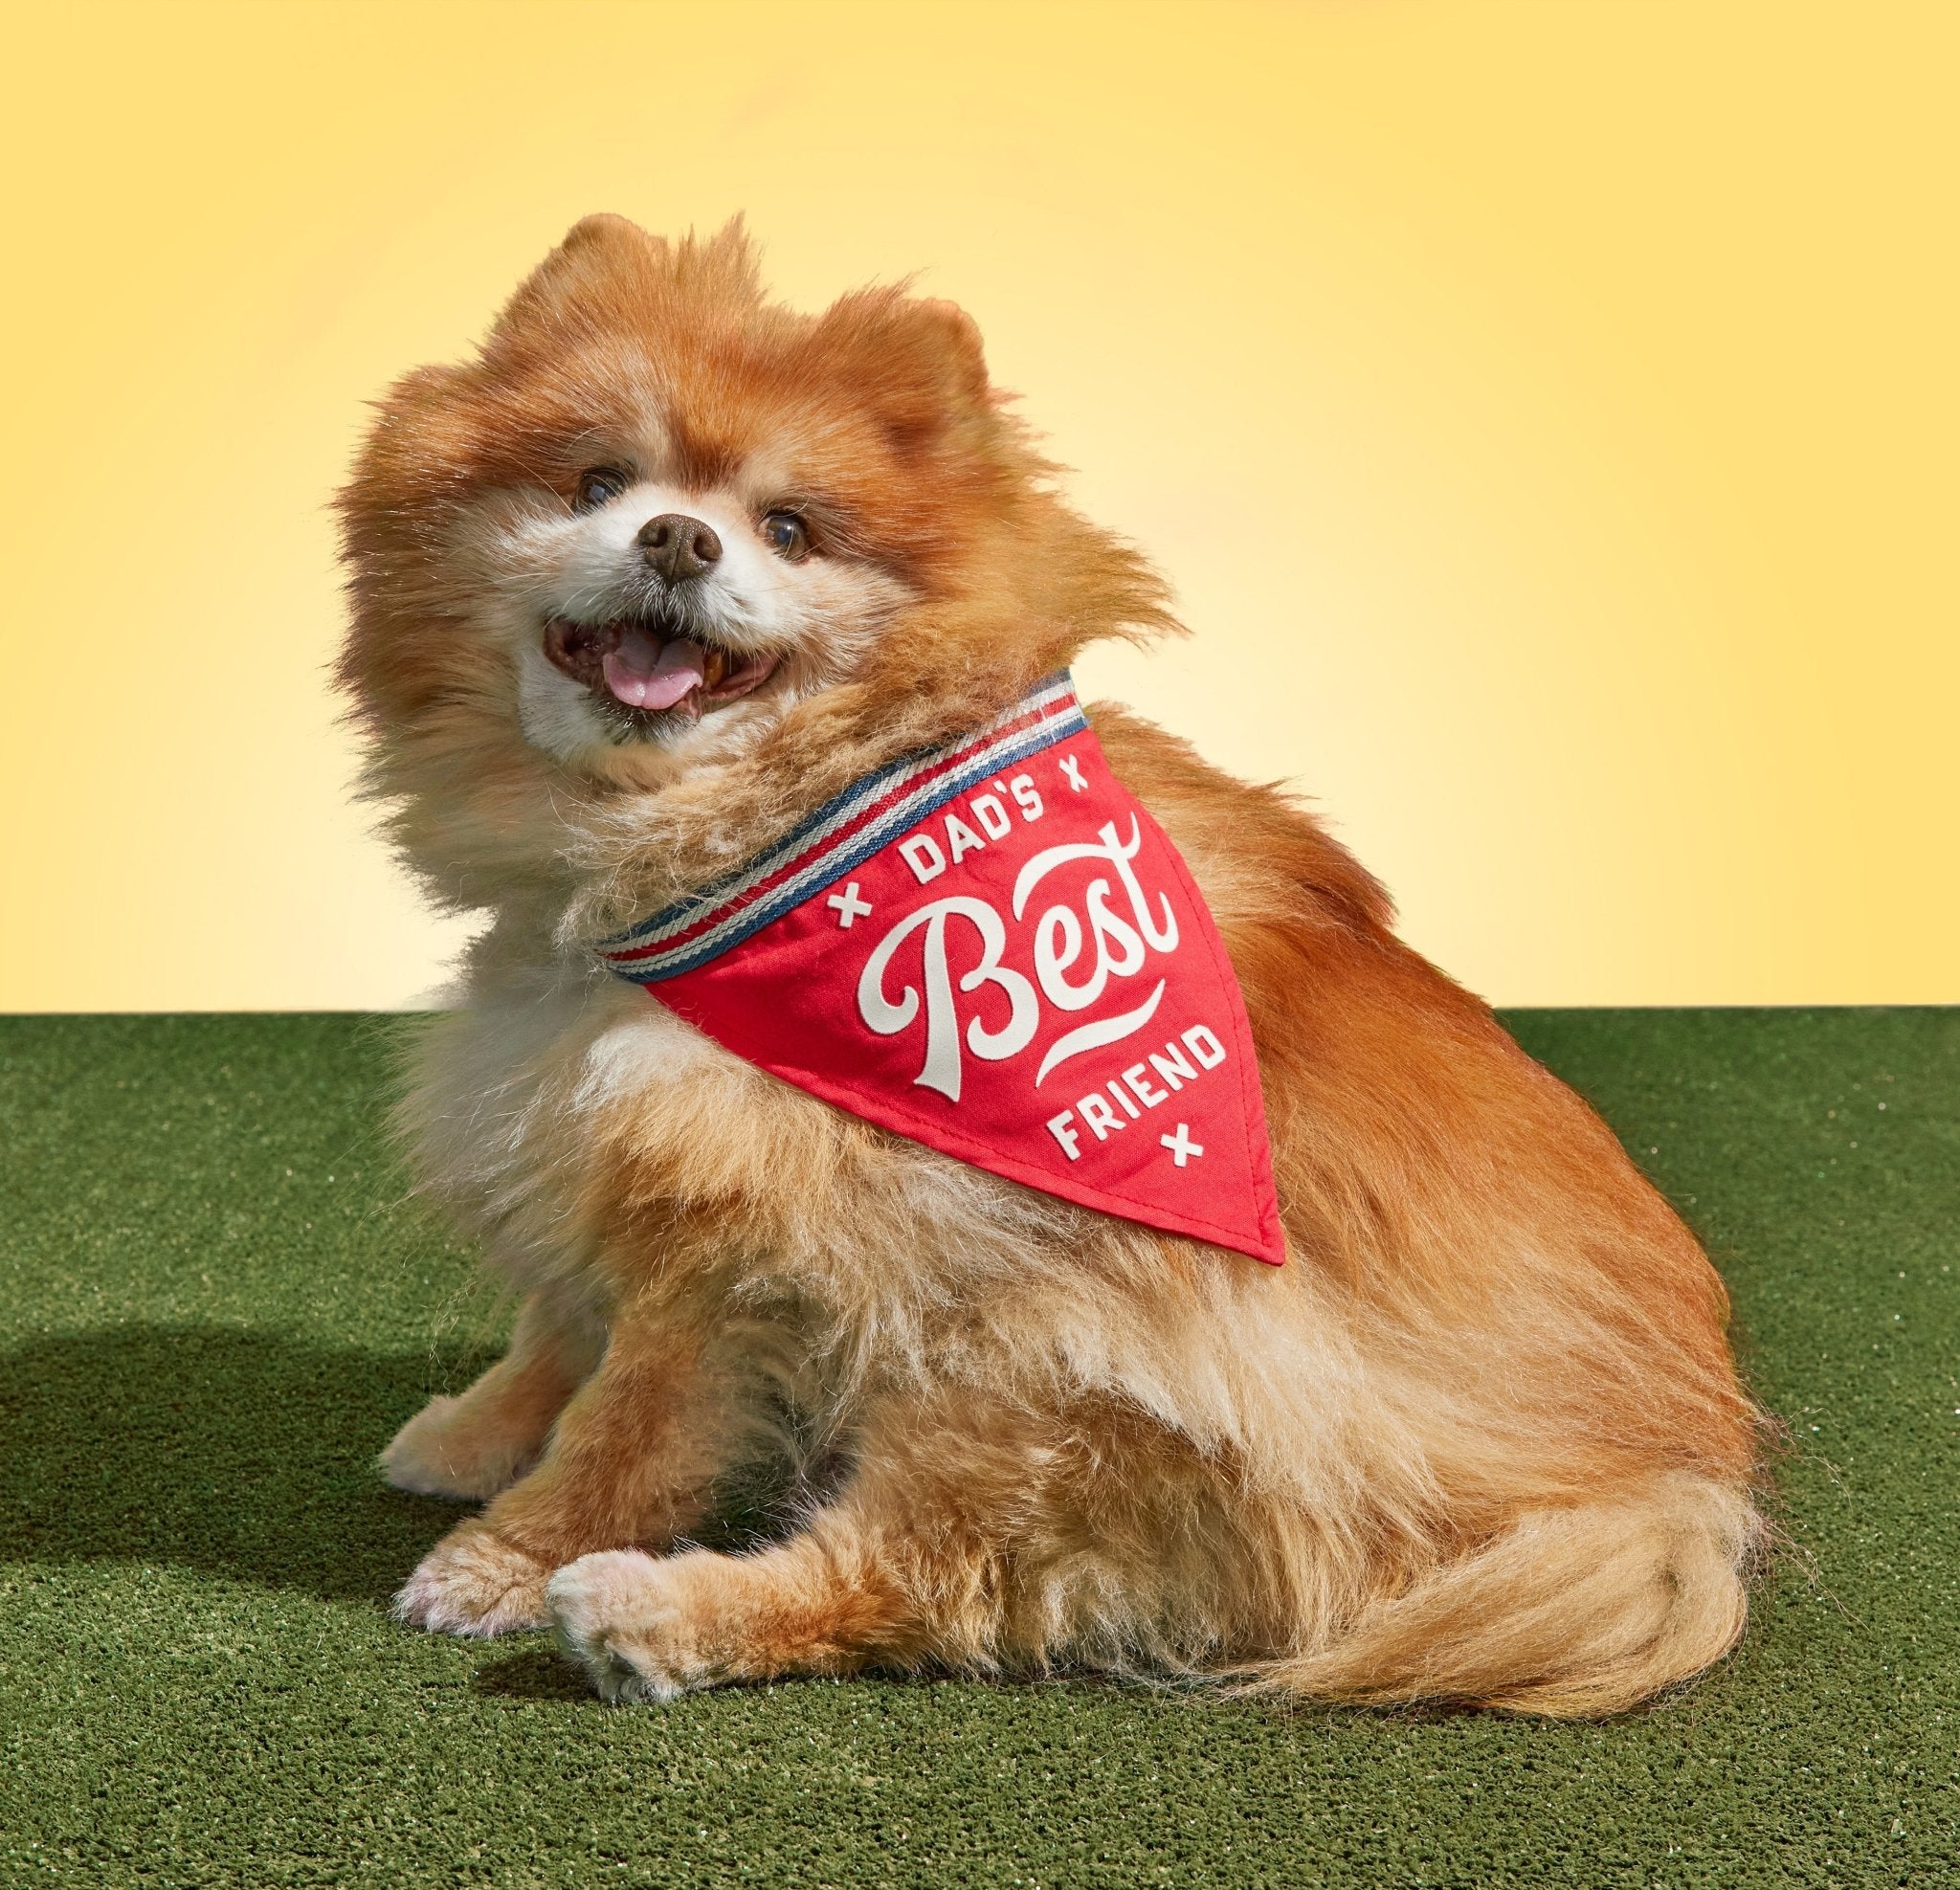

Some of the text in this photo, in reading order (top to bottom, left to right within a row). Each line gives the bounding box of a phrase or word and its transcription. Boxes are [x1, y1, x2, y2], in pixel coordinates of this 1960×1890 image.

[898, 773, 1044, 884] DAD'S
[857, 811, 1180, 1103] Best
[1046, 1024, 1227, 1161] FRIEND
